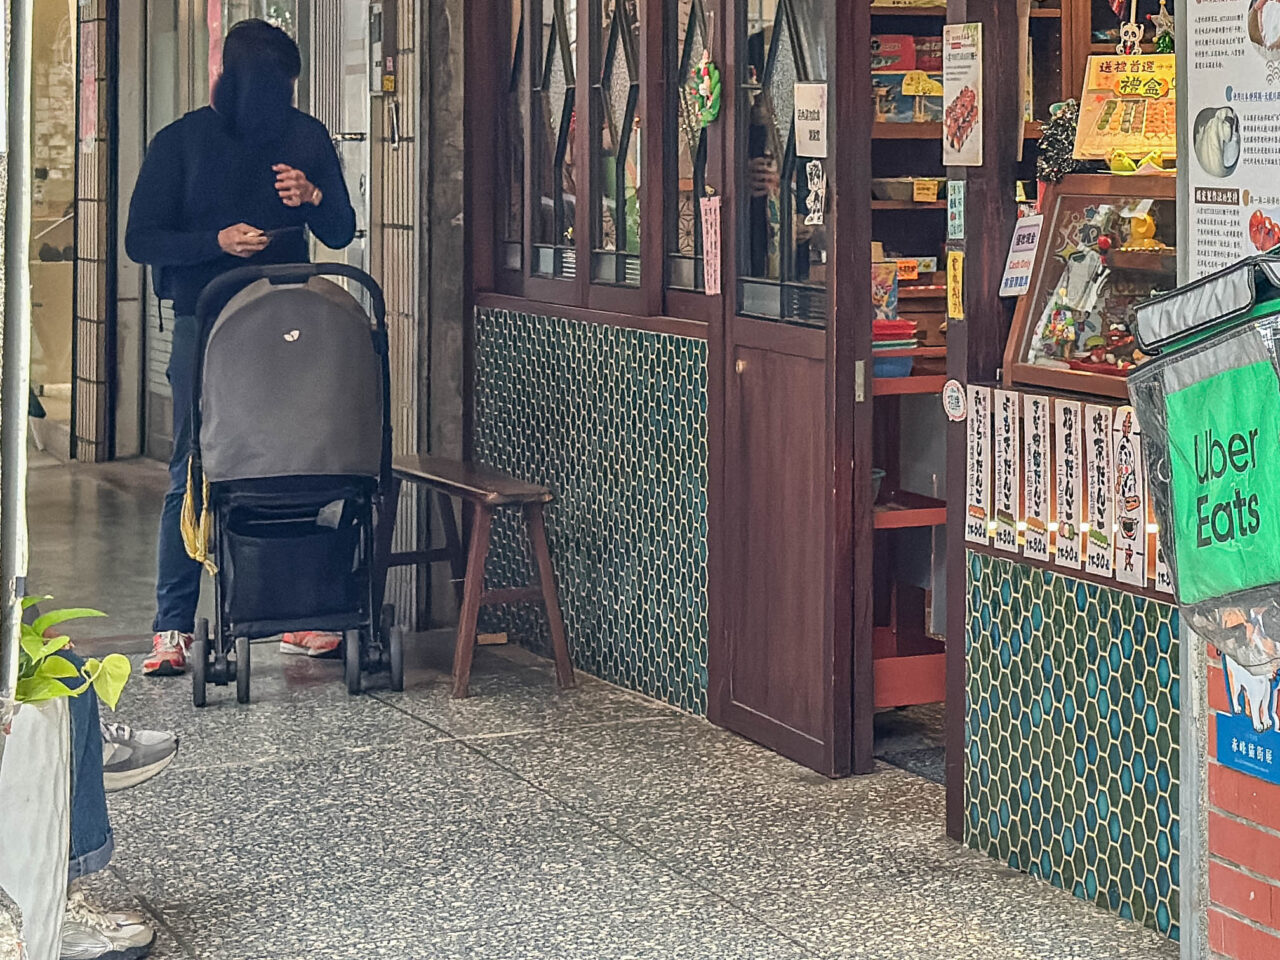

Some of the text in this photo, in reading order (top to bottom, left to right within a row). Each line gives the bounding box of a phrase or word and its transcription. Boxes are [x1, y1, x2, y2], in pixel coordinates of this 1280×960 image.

[1099, 60, 1156, 74] 送禮首選
[1120, 76, 1162, 96] 禮盒
[1194, 428, 1259, 484] Uber
[1196, 488, 1260, 548] Eats
